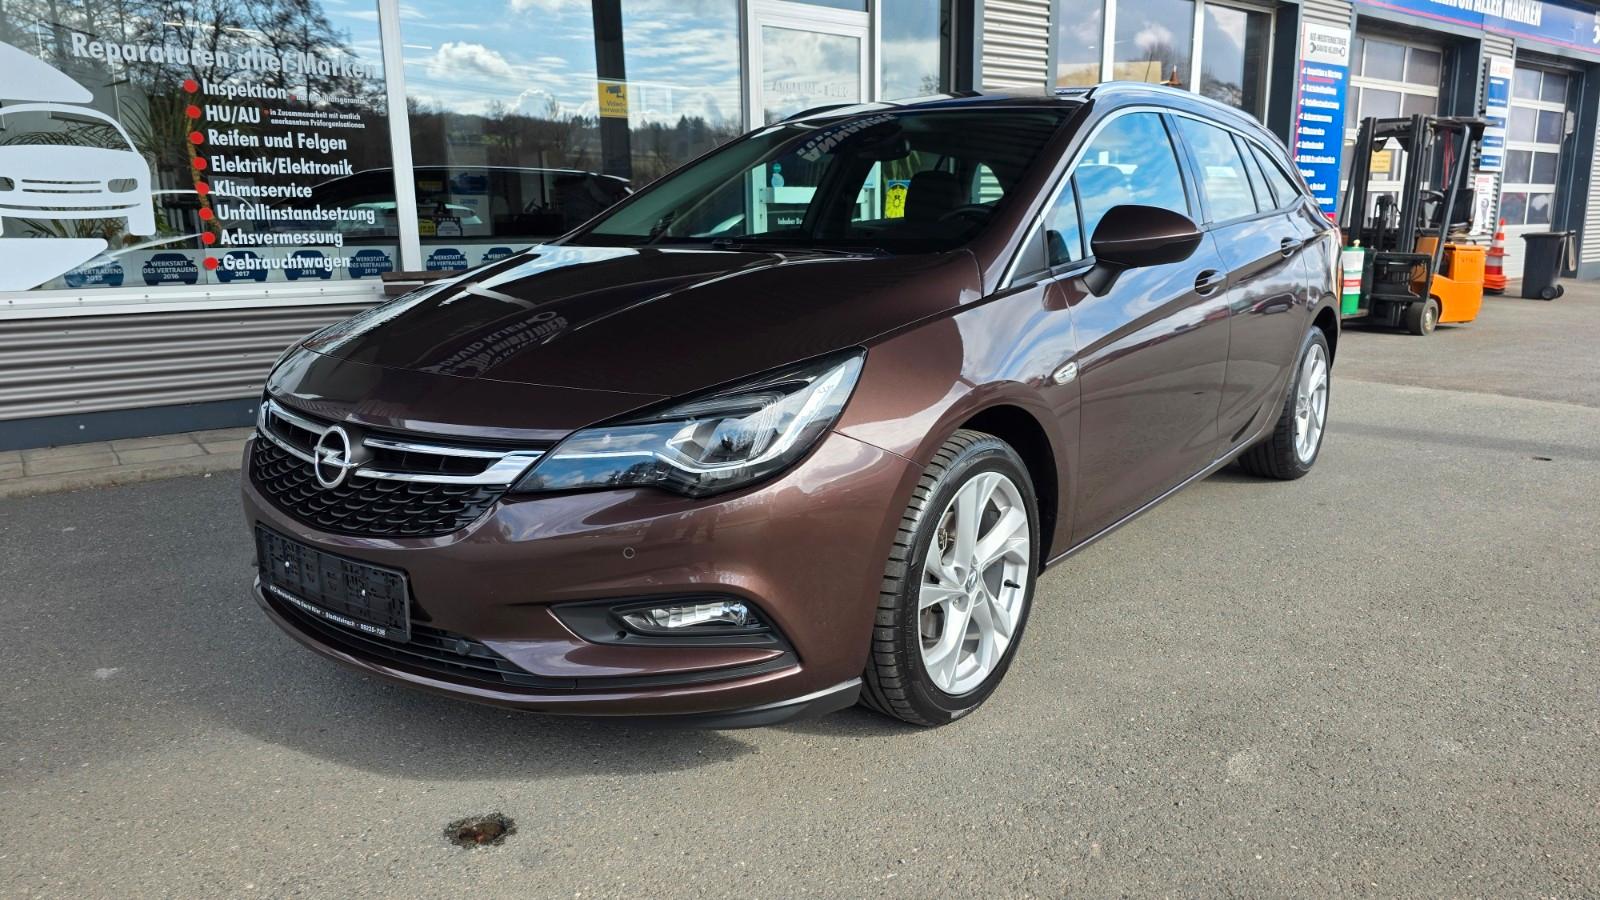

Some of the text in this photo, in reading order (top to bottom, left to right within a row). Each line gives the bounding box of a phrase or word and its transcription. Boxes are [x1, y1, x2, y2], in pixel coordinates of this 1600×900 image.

[71, 32, 377, 79] Reparaturen aller Marken
[203, 78, 287, 100] Inspektion
[206, 105, 261, 124] HU/AU
[270, 118, 365, 129] anerkannten Prüforganisationen
[278, 108, 328, 119] Zusammenarbeit
[339, 112, 361, 120] amtlich
[208, 128, 347, 154] Reifen und Felgen
[211, 155, 354, 175] Elektrik/Elektronik
[214, 180, 312, 198] Klimaservice
[217, 203, 375, 224] Unfallinstandsetzung
[220, 228, 343, 247] Achsvermessung
[223, 253, 350, 272] Gebrauchtwagen
